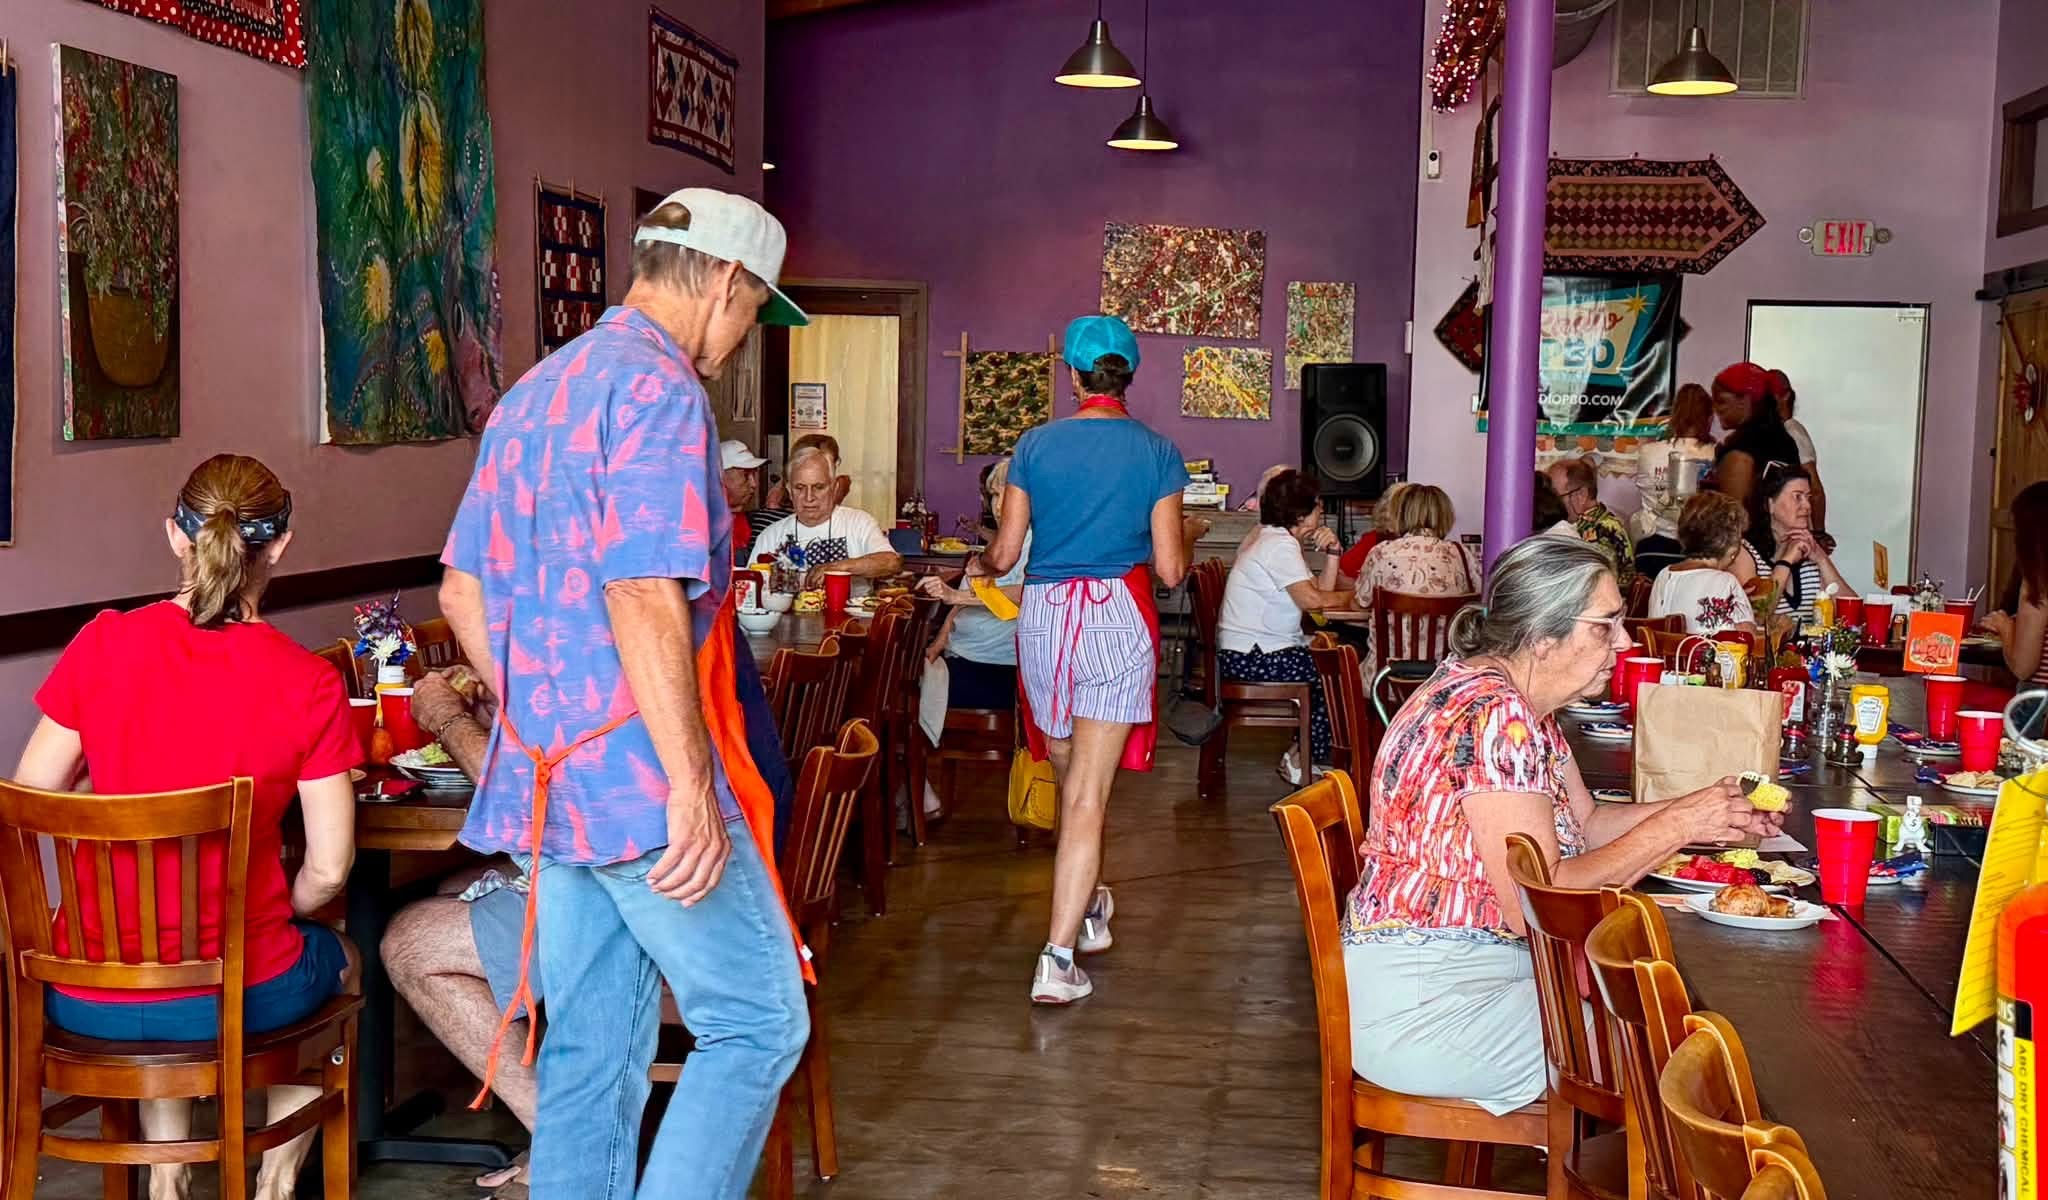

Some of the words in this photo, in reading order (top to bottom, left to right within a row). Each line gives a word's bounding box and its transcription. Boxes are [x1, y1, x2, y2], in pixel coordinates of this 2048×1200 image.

[1824, 222, 1867, 254] EXIT
[1539, 394, 1621, 406] DIOPBO.COM
[2018, 1044, 2028, 1078] ABC
[2018, 1081, 2029, 1112] DRY
[2019, 1116, 2030, 1193] CHEMICAL
